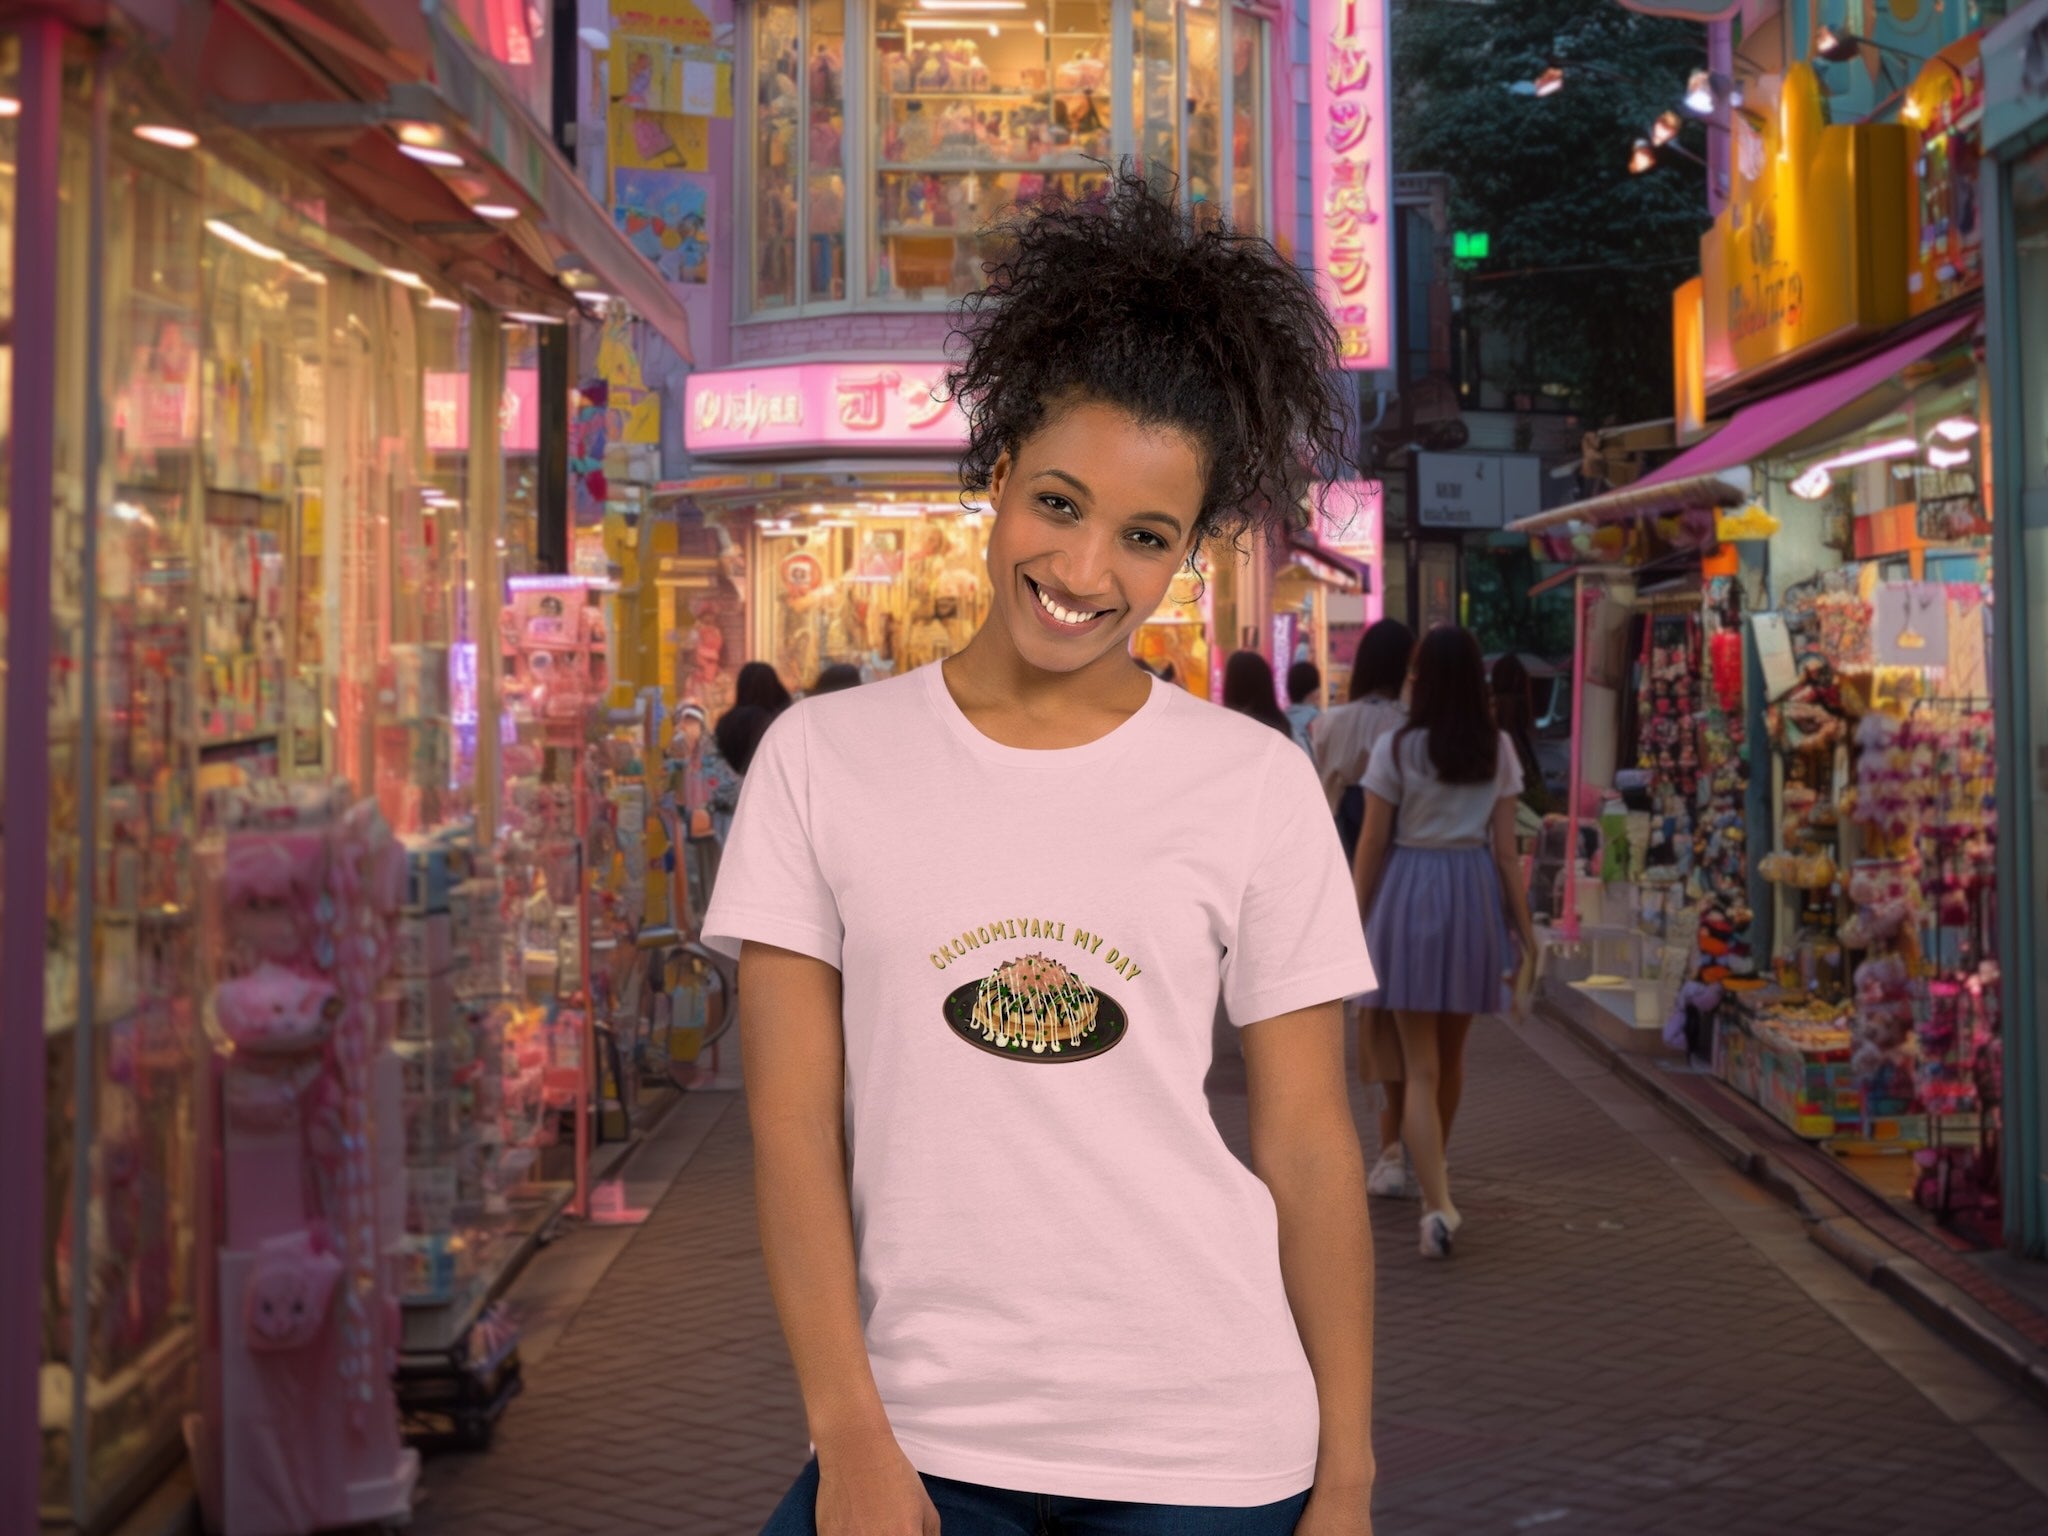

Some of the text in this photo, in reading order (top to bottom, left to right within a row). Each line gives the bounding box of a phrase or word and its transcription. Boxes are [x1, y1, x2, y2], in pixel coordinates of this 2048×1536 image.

[929, 917, 1142, 982] OKONOMIYAKI MY DAY
